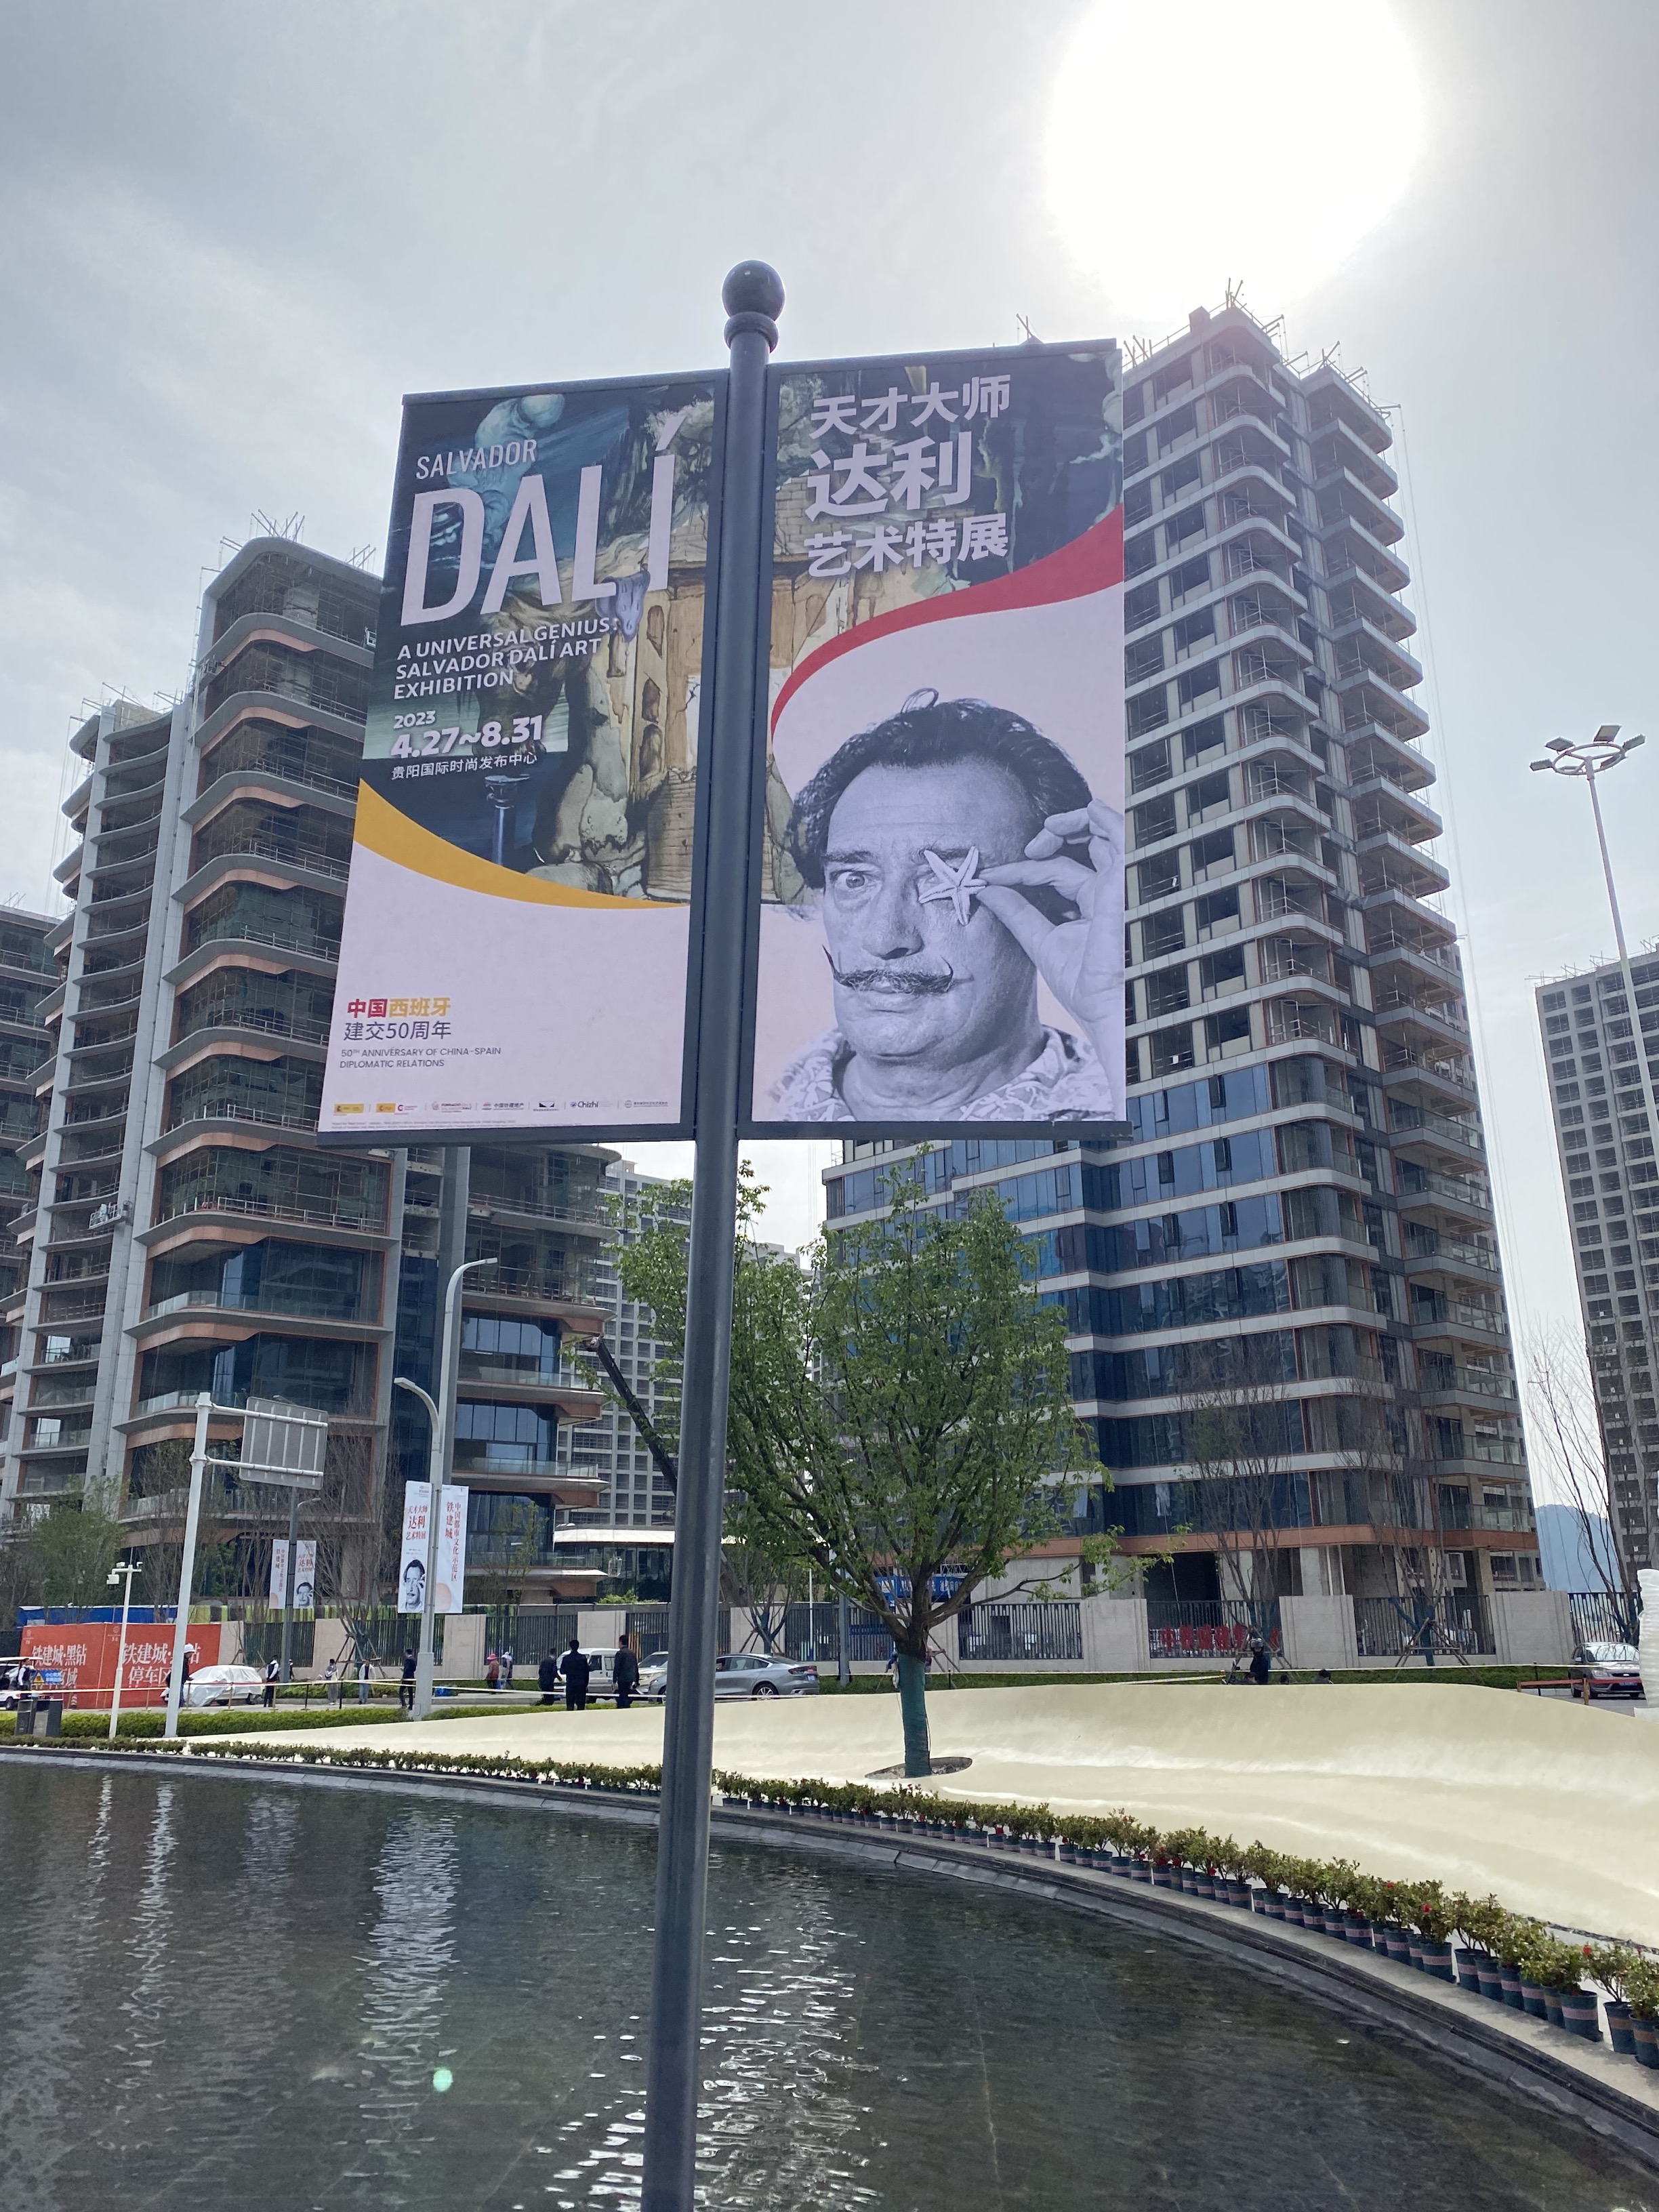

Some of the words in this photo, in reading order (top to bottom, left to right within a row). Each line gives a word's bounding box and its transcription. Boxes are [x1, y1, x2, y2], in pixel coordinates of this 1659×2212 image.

[809, 375, 1010, 438] 天才大师
[415, 439, 537, 480] SALVADOR
[804, 432, 972, 521] 达利
[401, 415, 687, 626] DALÍ
[804, 513, 1008, 577] 艺术特展
[397, 645, 411, 660] A
[416, 629, 529, 657] UNIVERSAL
[534, 617, 617, 641] GENIUS:
[396, 651, 504, 680] SALVADOR
[509, 639, 556, 665] DALÍ
[559, 638, 601, 658] ART
[394, 670, 514, 699] EXHIBITION
[394, 710, 436, 729] 2023
[390, 715, 543, 759] 4.27~8.31
[391, 752, 537, 780] 贵阳国际时尚发布中心
[347, 998, 451, 1018] 中国西班牙
[344, 1020, 451, 1041] 建交50周年
[340, 1060, 394, 1069] DIPLOMATIC
[396, 1059, 445, 1068] RELATIONS
[426, 1048, 438, 1056] OF
[440, 1047, 501, 1056] CHINA-SPAIN
[577, 1101, 599, 1109] Chizhi
[408, 1515, 426, 1530] 达利
[445, 1501, 454, 1539] 铁建城
